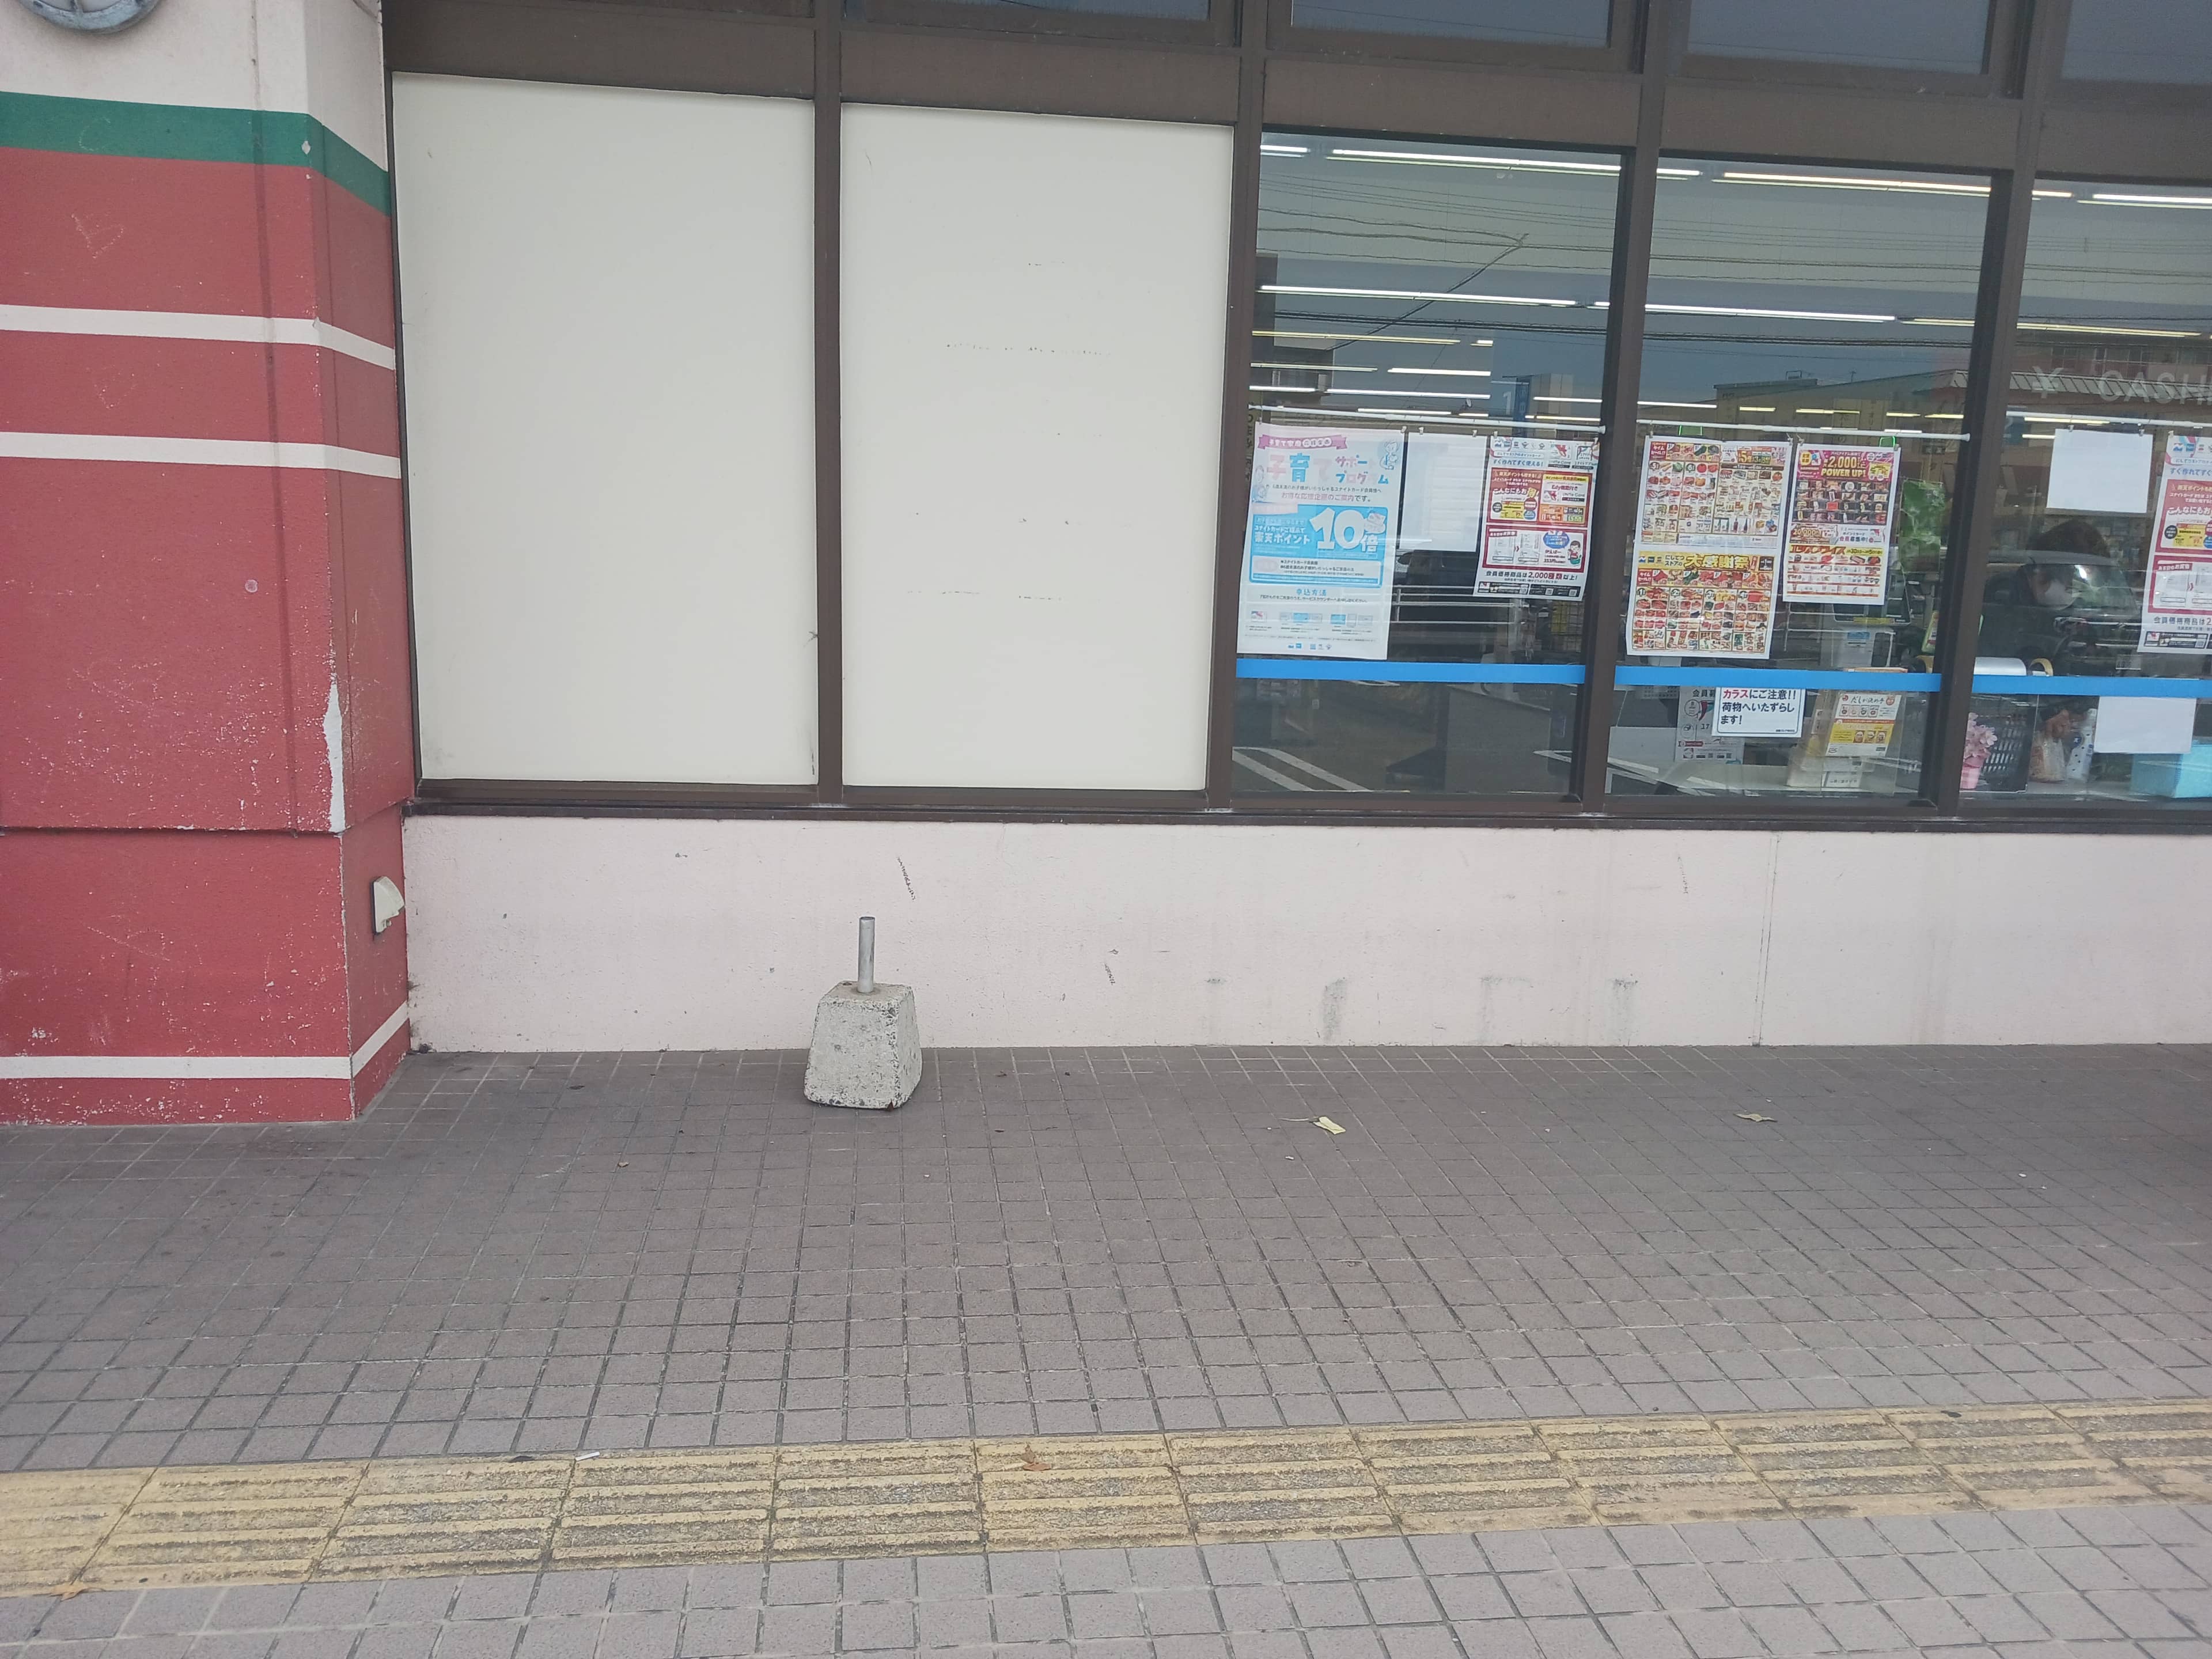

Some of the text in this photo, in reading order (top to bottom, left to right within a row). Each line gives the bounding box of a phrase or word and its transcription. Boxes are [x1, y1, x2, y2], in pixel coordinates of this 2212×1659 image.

[1820, 468, 1866, 478] POWER UP!
[1255, 532, 1310, 545] 楽天ポイント
[1683, 554, 1750, 570] 大感謝祭
[1723, 689, 1796, 700] カラスにご注意!!
[1722, 702, 1795, 713] 荷物へいたずらし
[1721, 715, 1743, 725] ます!
